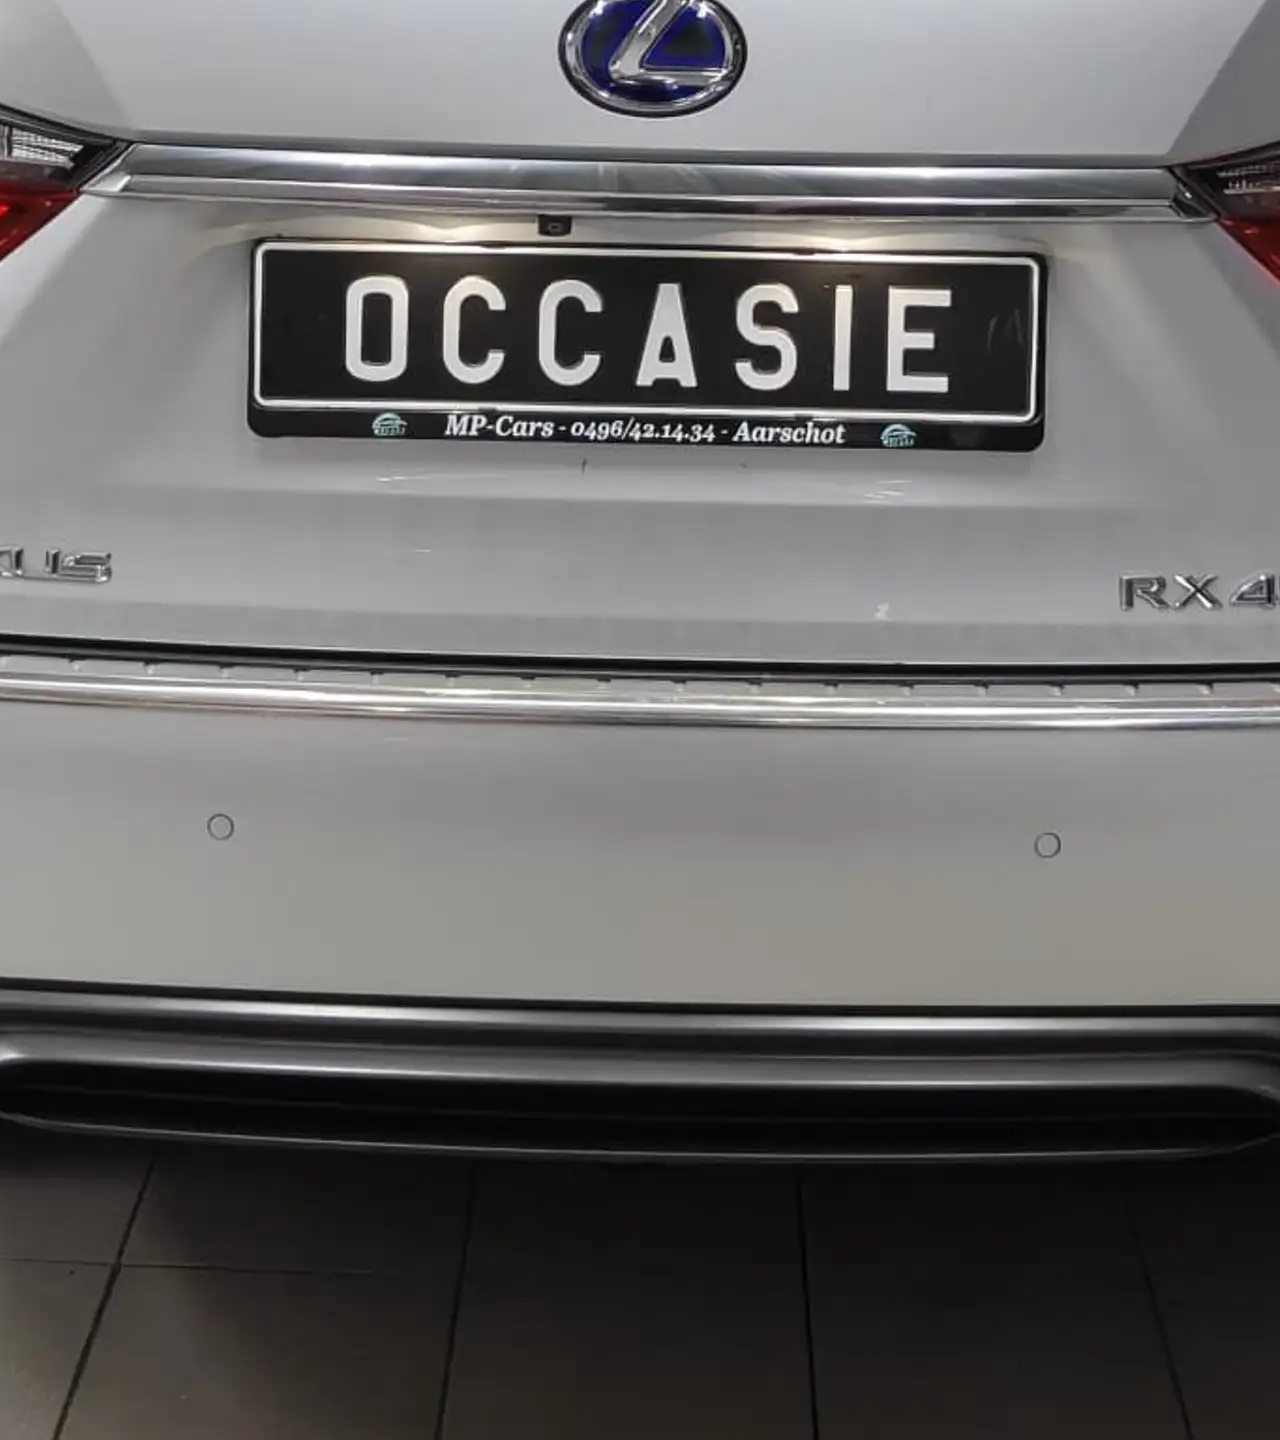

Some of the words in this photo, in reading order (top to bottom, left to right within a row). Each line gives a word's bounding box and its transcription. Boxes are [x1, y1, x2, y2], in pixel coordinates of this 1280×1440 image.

[344, 274, 953, 393] OCCASIE
[445, 414, 555, 438] MP-Cars
[570, 416, 716, 443] 0496/42.14.34
[732, 420, 846, 444] Aarschot
[1120, 573, 1222, 611] RX
